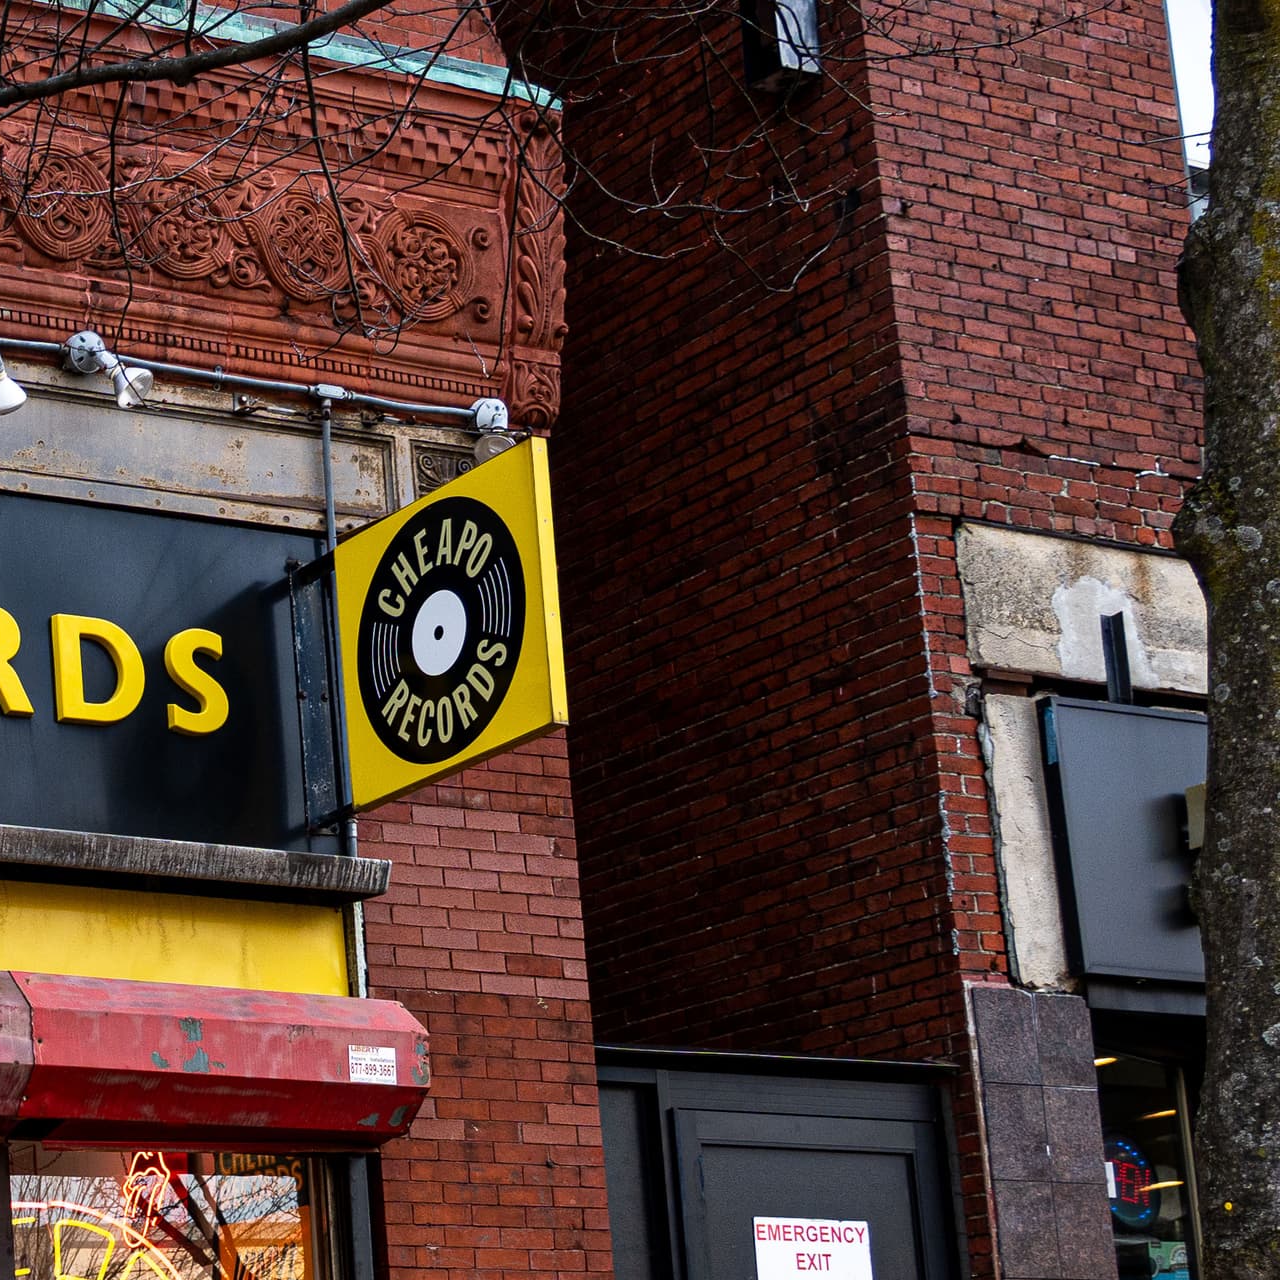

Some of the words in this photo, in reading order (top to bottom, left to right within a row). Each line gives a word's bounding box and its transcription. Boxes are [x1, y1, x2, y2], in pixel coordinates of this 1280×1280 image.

[378, 518, 493, 617] CHEAPO
[381, 639, 507, 747] RECORDS
[756, 1223, 865, 1244] EMERGENCY
[796, 1252, 832, 1271] EXIT
